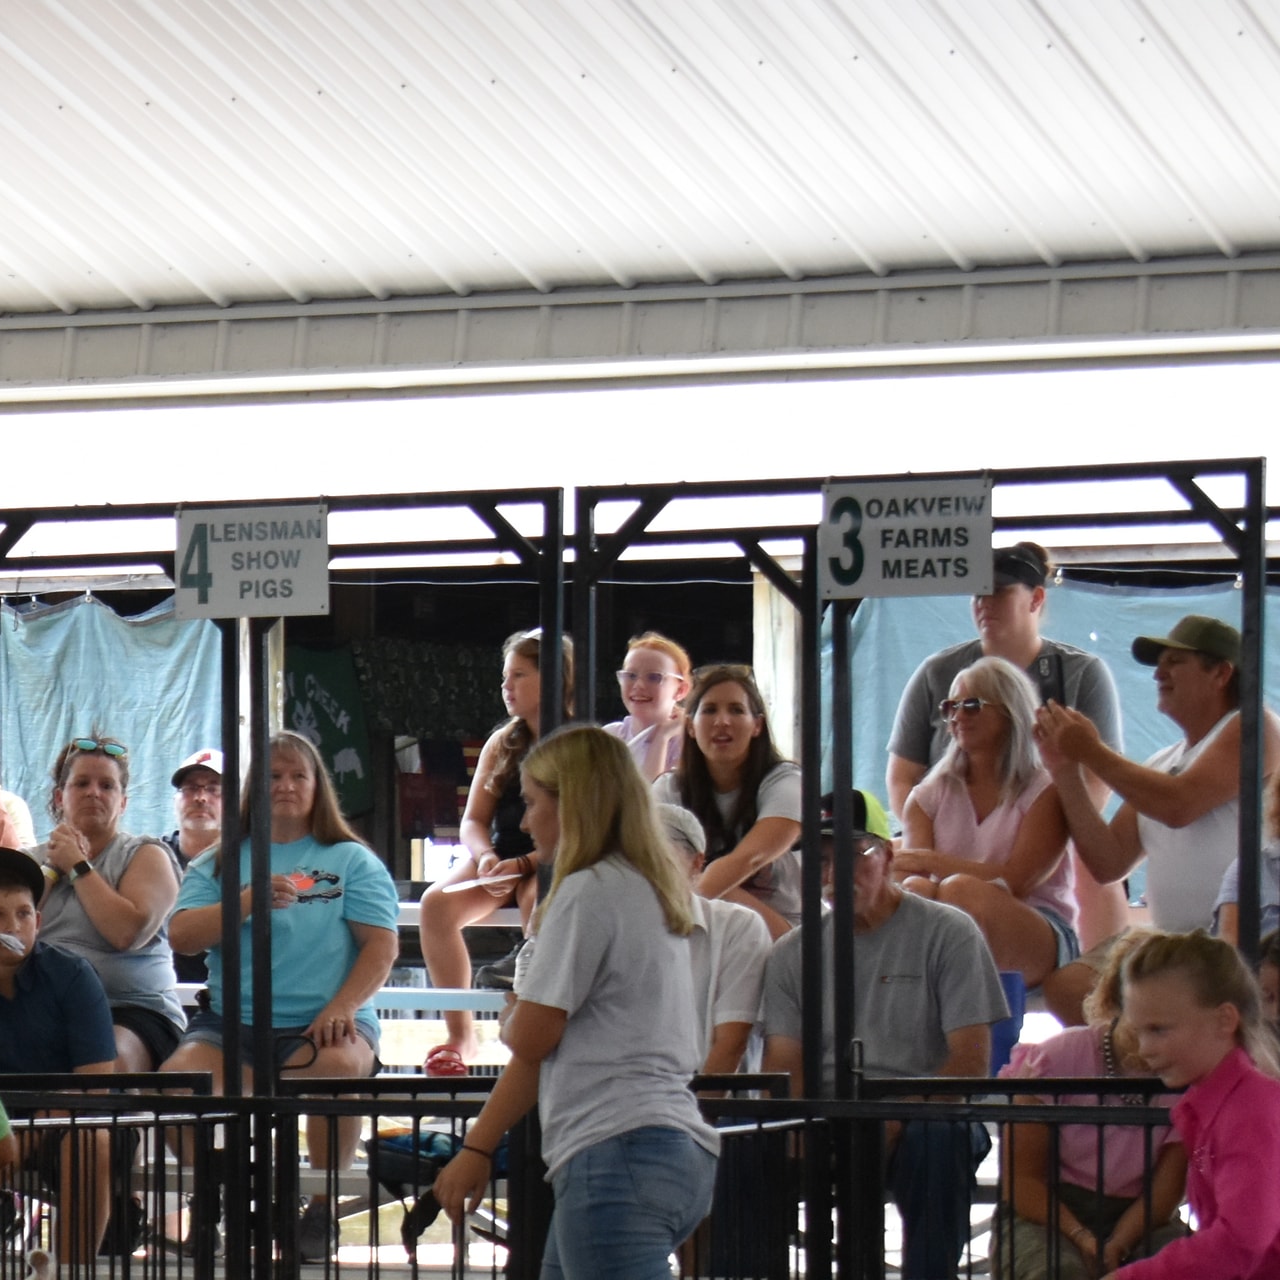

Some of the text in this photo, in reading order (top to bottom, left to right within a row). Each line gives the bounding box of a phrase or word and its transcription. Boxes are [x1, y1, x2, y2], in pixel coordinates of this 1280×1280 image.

[865, 496, 985, 519] OAKVEIW
[210, 519, 322, 543] LENSMAN
[828, 497, 865, 586] 3
[881, 527, 969, 548] FARMS
[180, 524, 213, 604] 4
[231, 550, 300, 571] SHOW
[882, 558, 969, 579] MEATS
[240, 579, 292, 598] PIGS
